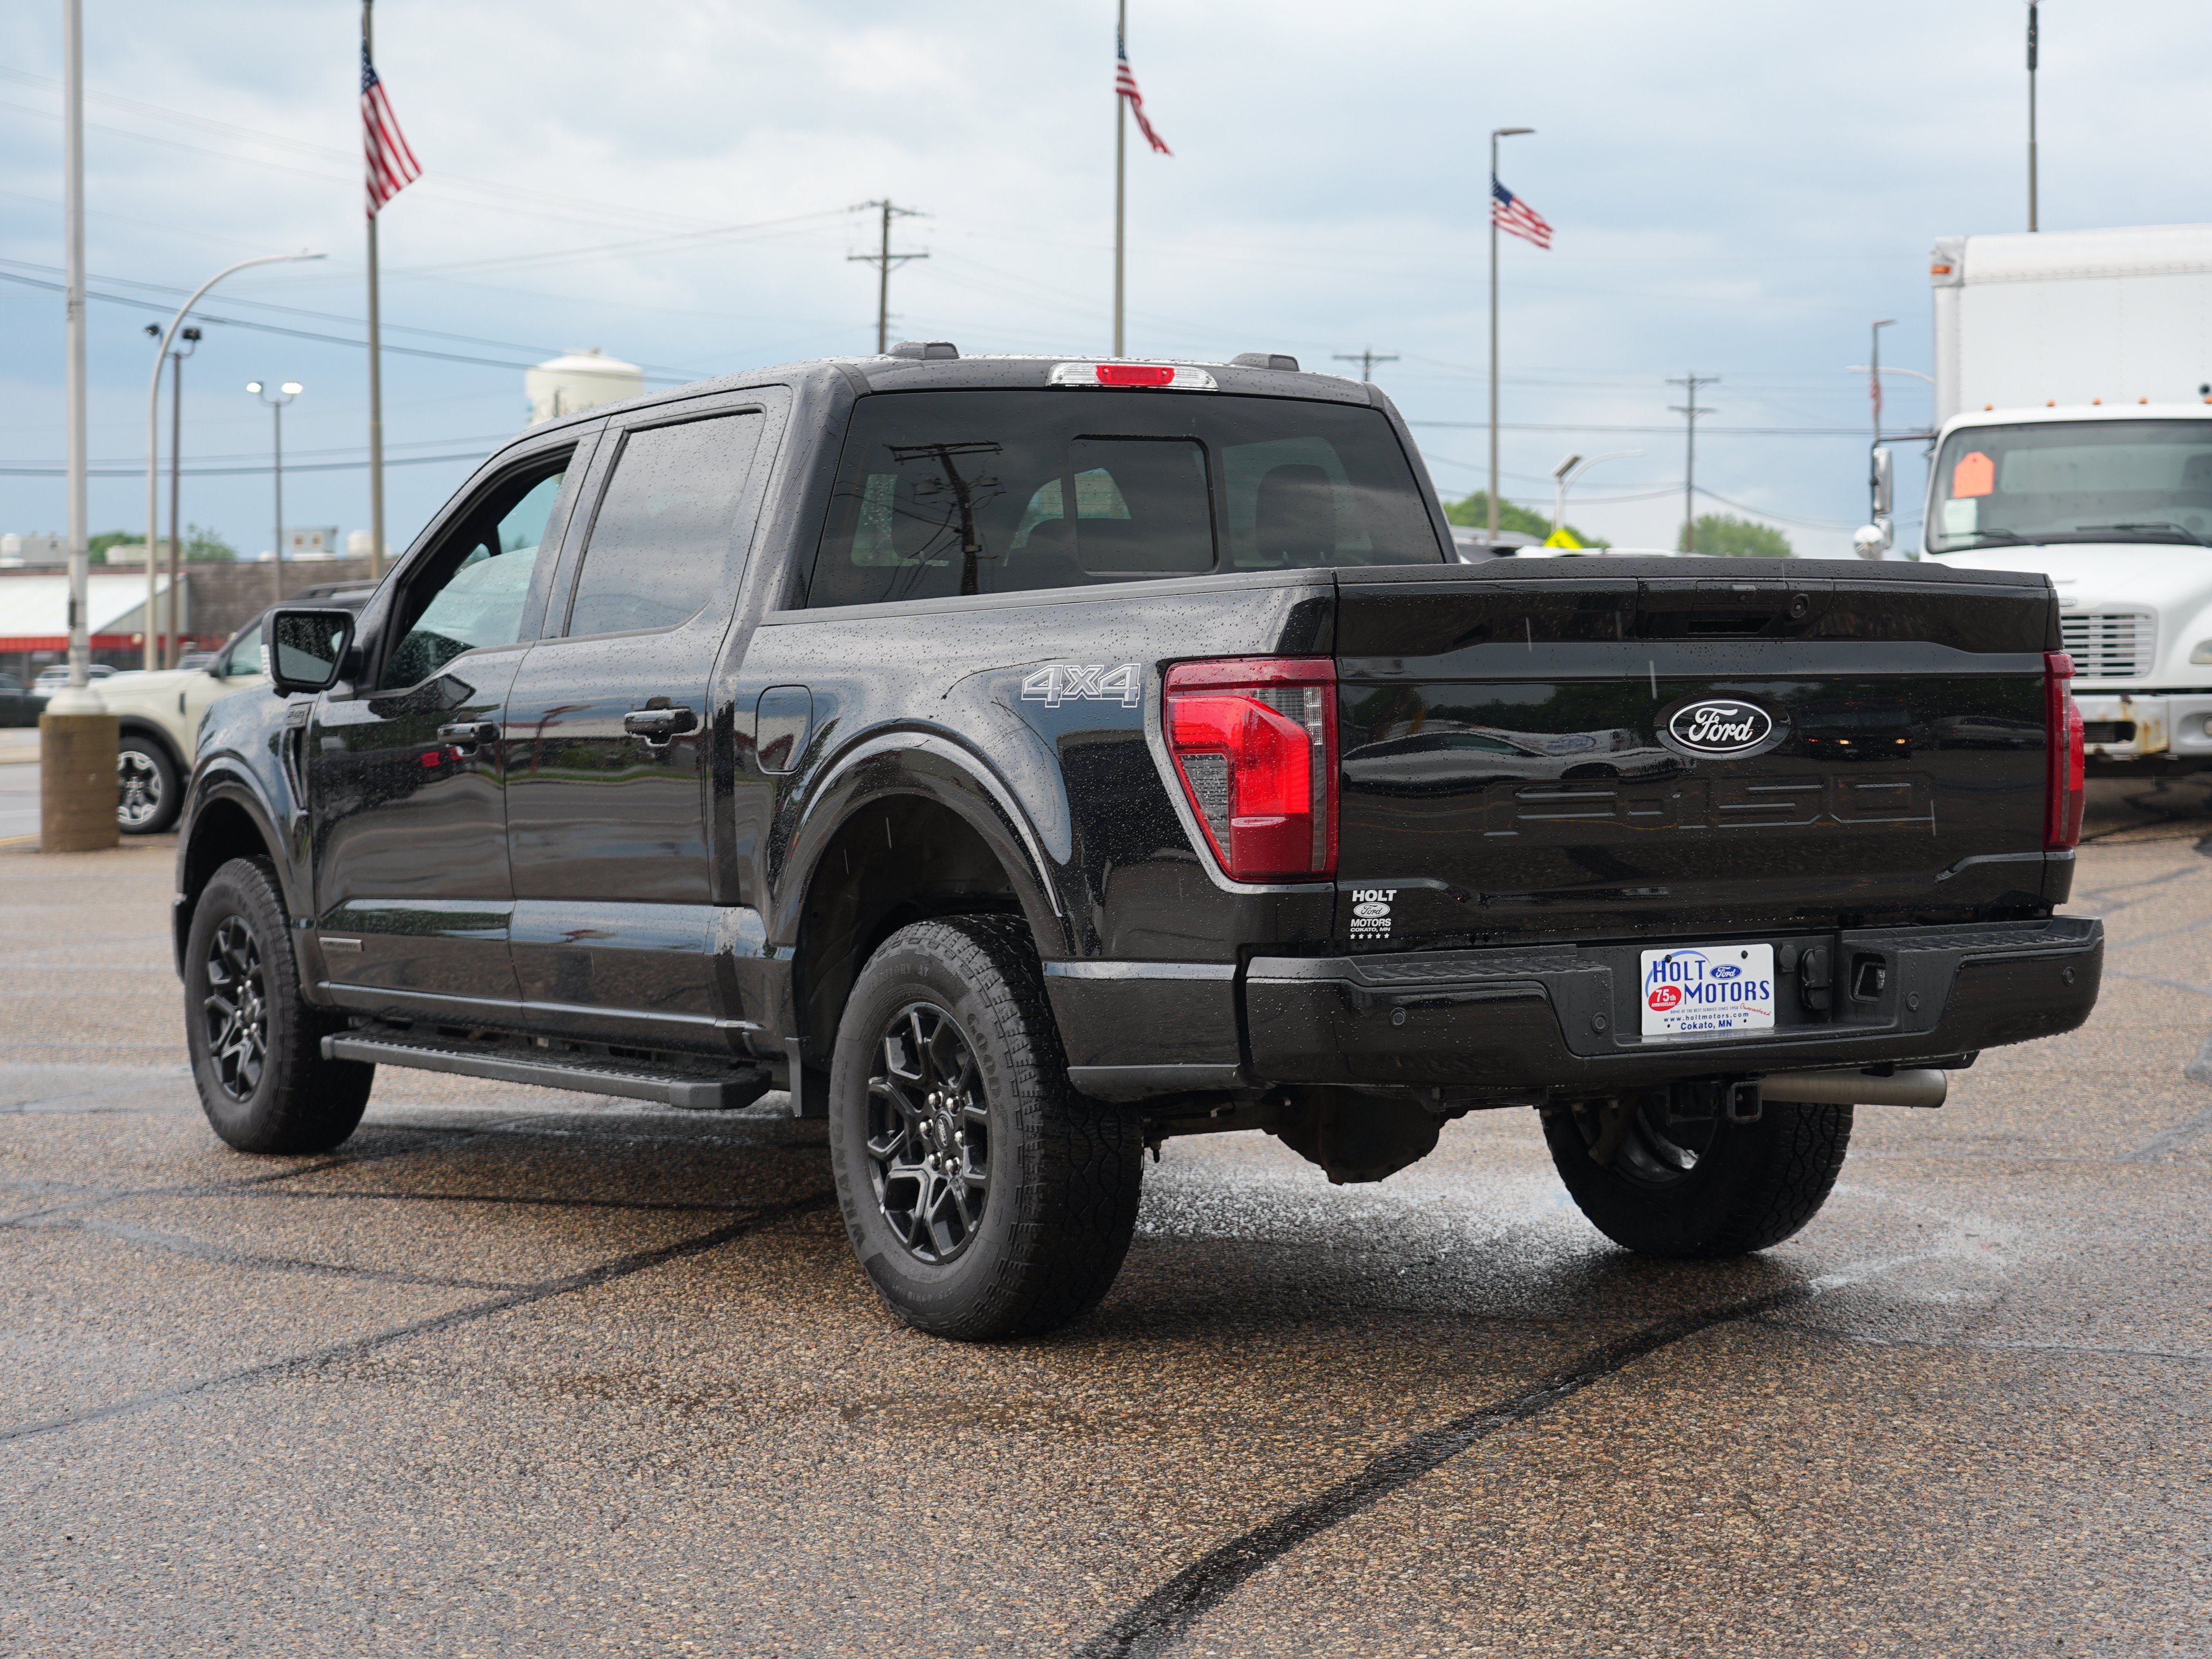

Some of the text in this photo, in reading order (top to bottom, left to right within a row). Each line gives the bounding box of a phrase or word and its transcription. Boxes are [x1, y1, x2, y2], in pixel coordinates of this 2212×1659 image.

[1689, 707, 1754, 741] Ford
[1352, 889, 1397, 901] HOLT
[1361, 905, 1383, 915] Ford
[1351, 918, 1391, 927] MOTORS
[1653, 960, 1705, 982] HOLT
[1716, 966, 1737, 978] Ford
[1655, 989, 1676, 1003] 75th
[1684, 980, 1769, 1004] MOTORS
[1740, 1003, 1771, 1016] Guaranteed
[1664, 1011, 1749, 1022] www.holtmotors.com
[1681, 1021, 1715, 1030] Cokato,
